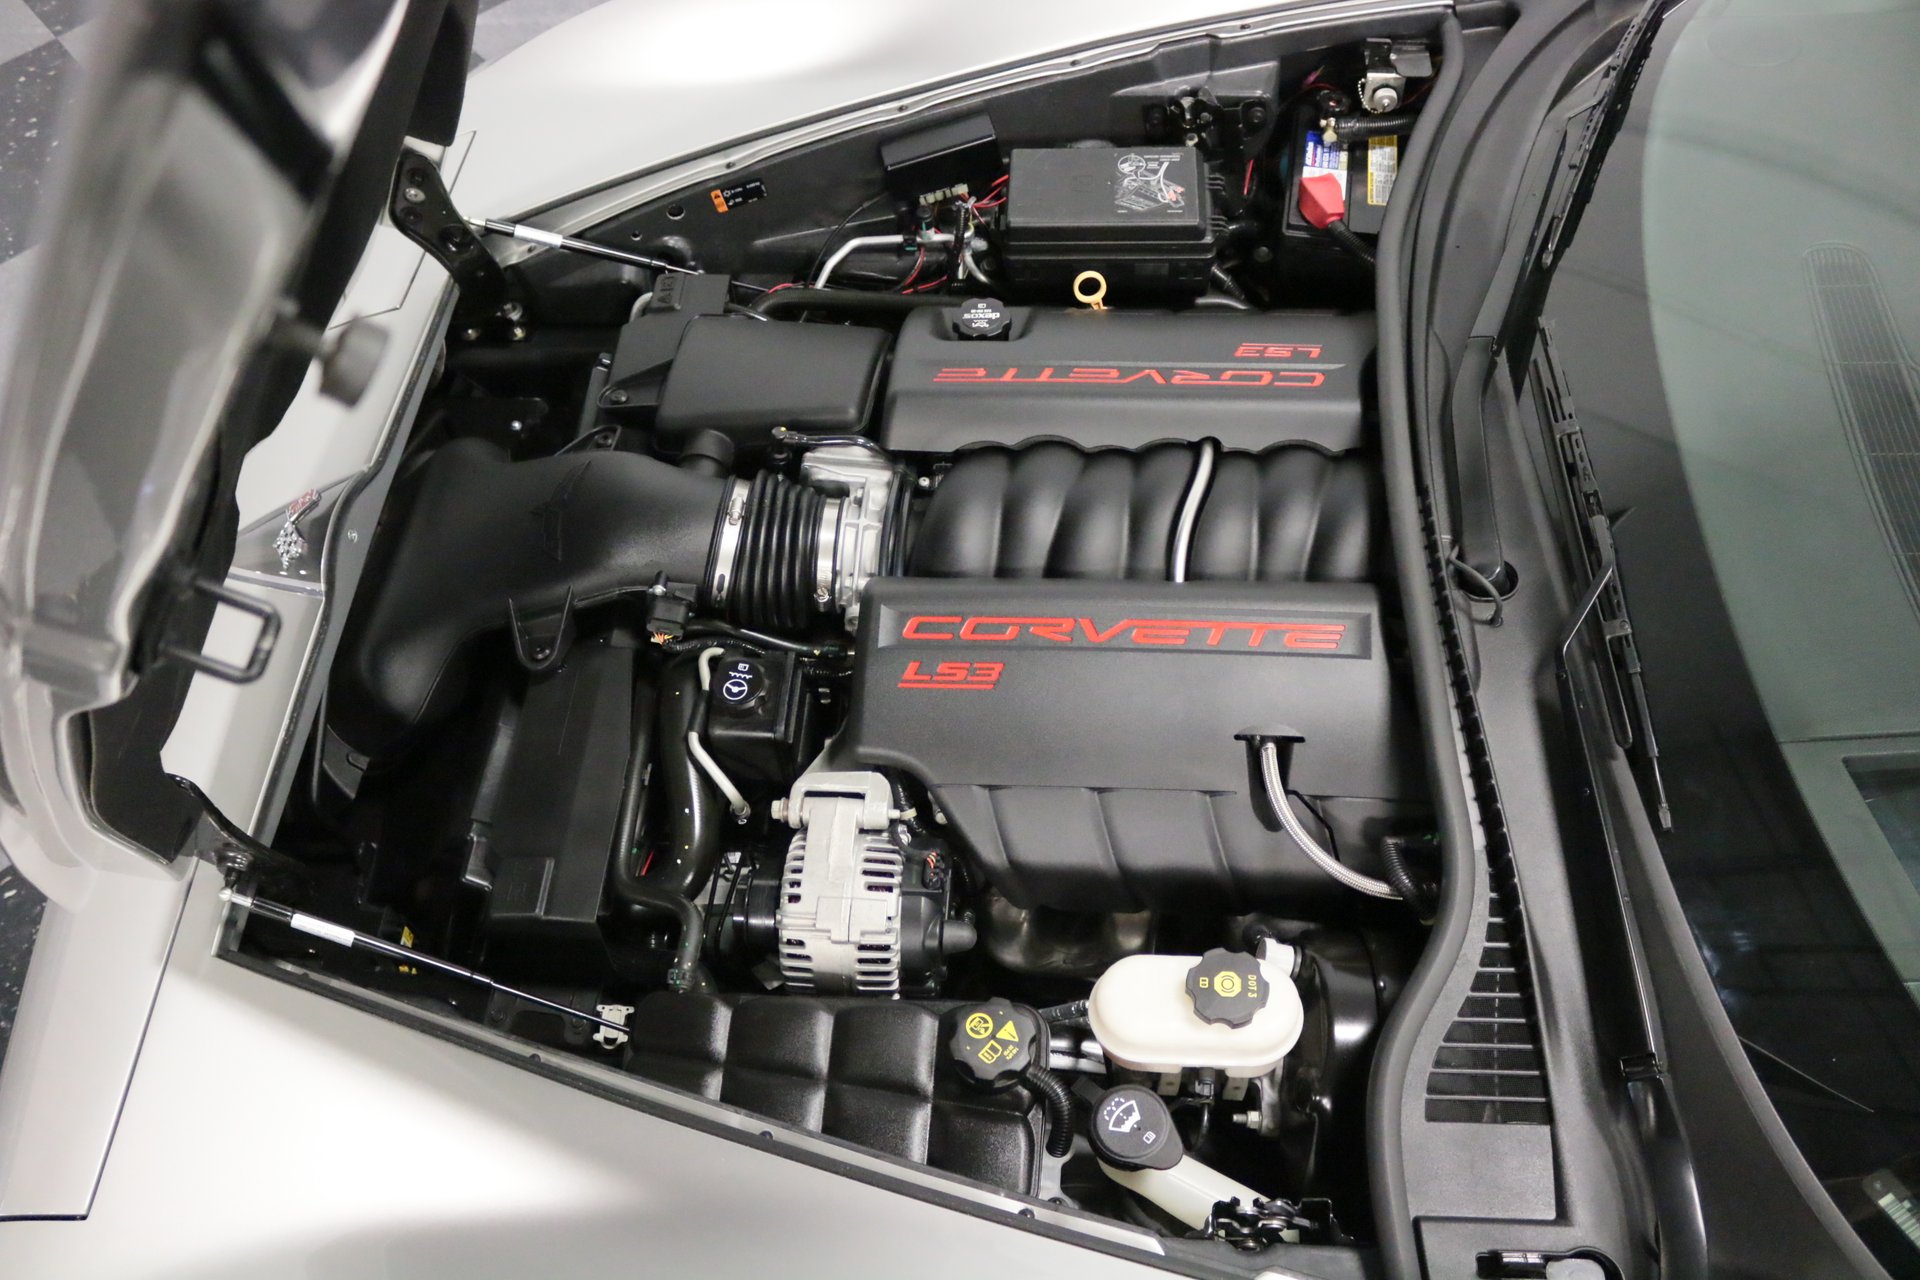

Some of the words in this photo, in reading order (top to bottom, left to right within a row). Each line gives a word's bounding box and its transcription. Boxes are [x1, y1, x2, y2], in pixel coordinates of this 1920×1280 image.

[1234, 344, 1322, 358] LS3
[933, 367, 1325, 387] CORVETTE
[902, 616, 1345, 649] CORVETTE
[899, 661, 1004, 688] LS3
[1248, 974, 1257, 991] DOT
